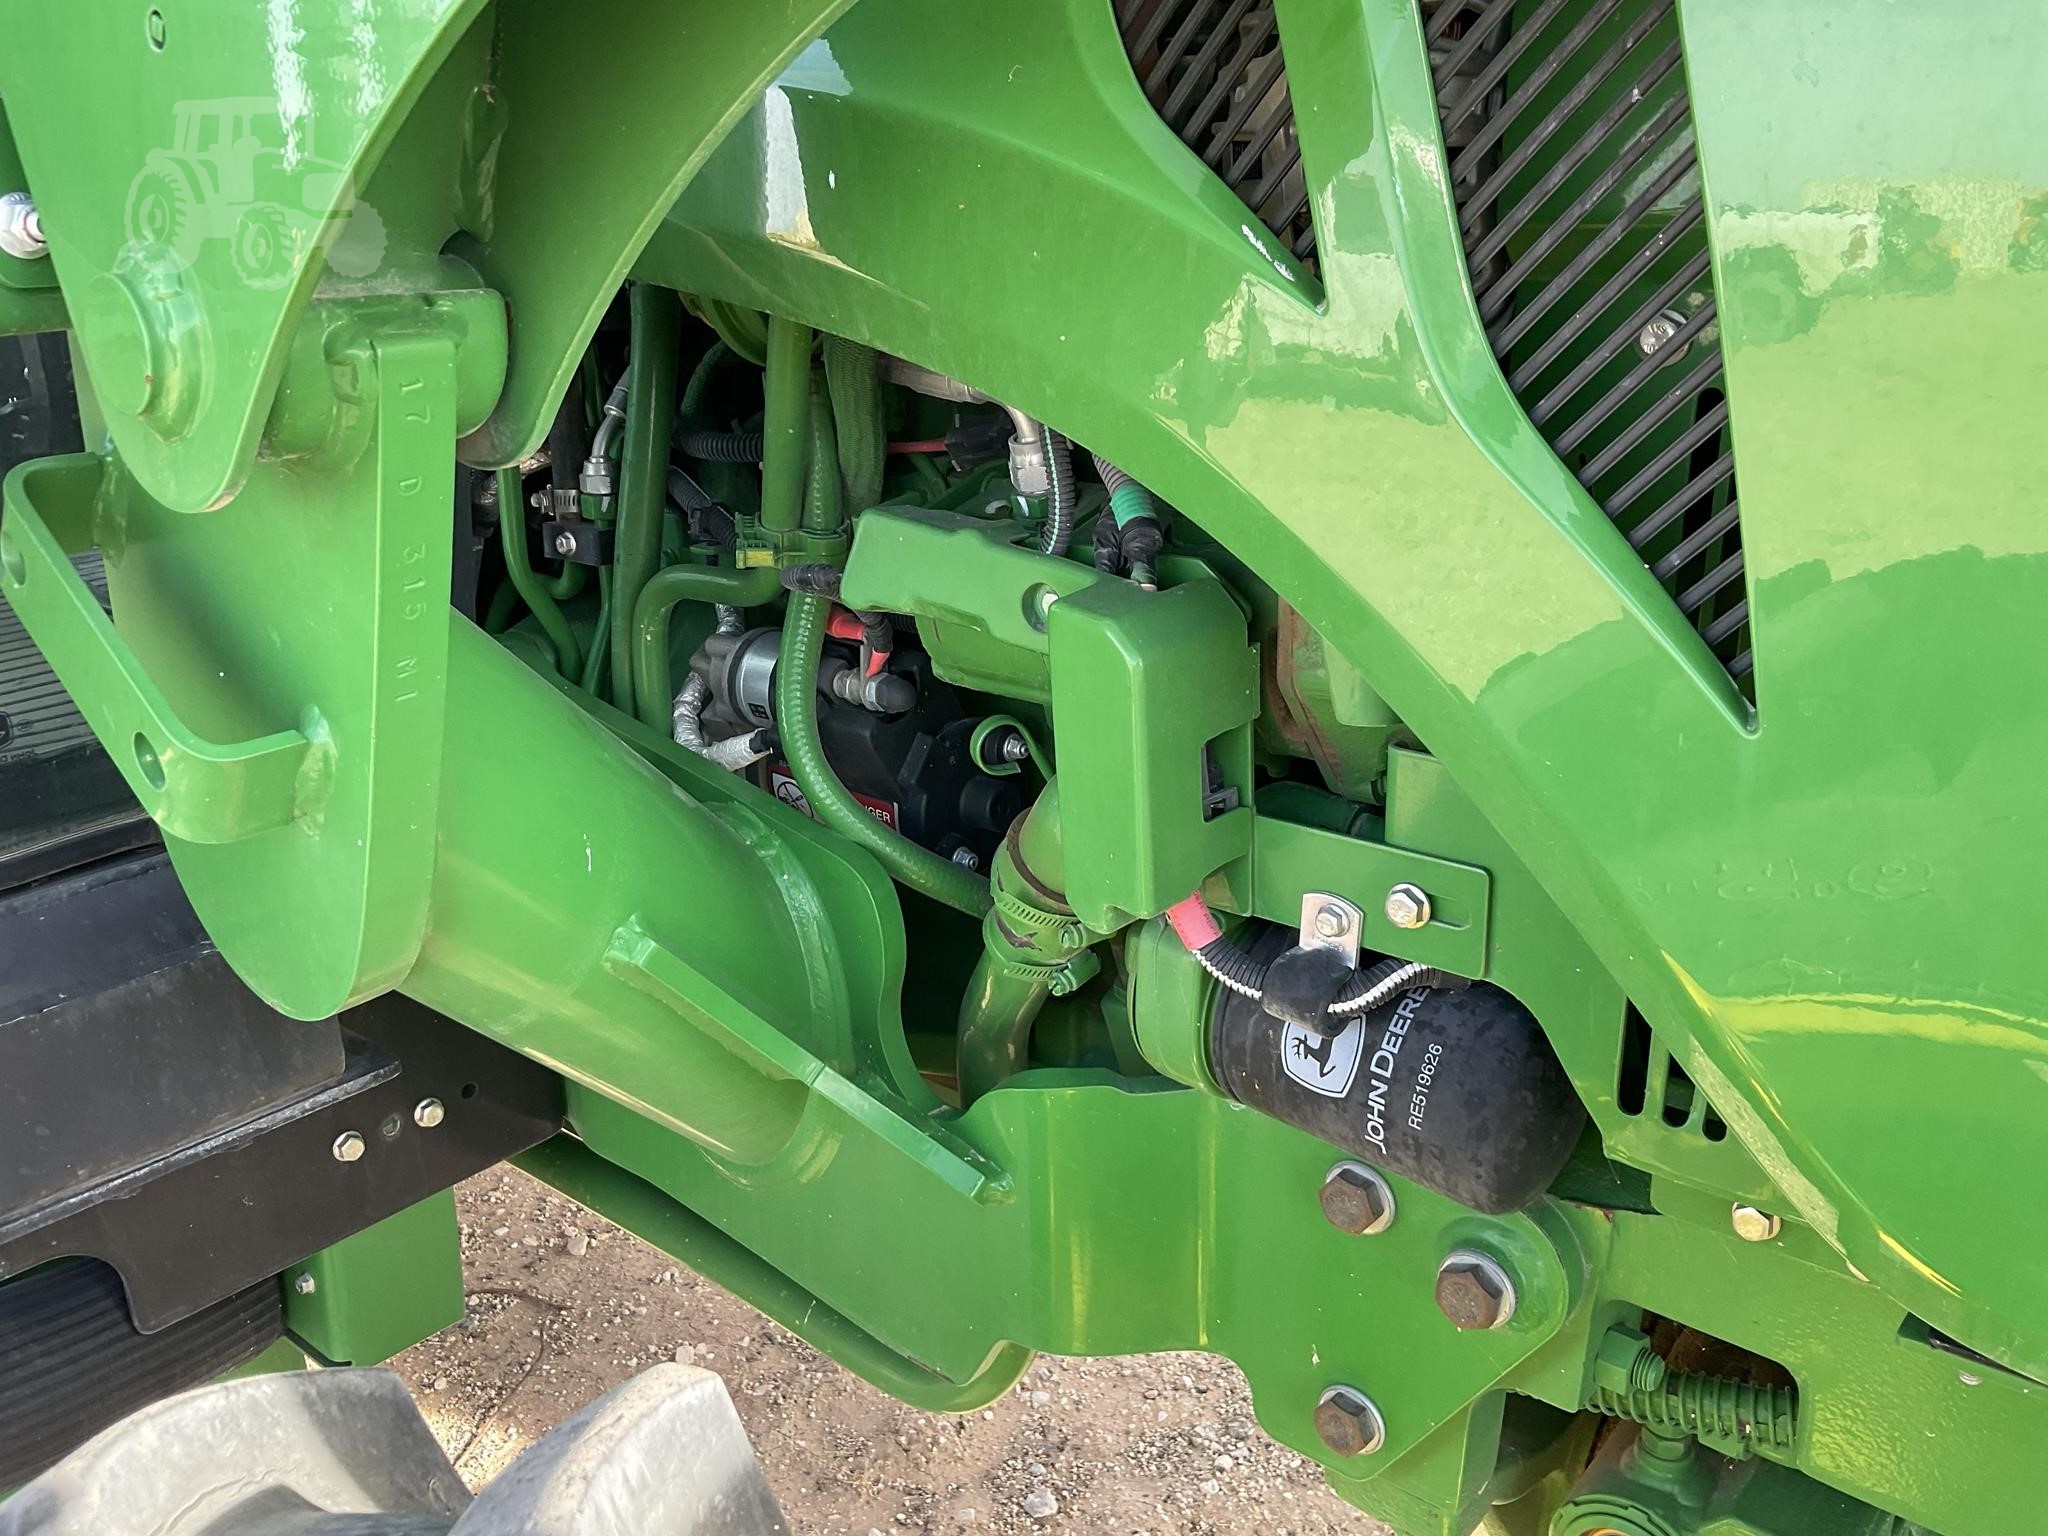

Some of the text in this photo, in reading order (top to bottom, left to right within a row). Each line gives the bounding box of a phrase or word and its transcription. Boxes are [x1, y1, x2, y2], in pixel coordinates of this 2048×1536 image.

[400, 379, 430, 423] 17
[403, 543, 426, 620] 315
[1364, 987, 1431, 1155] JOHN DEERE
[1408, 1043, 1443, 1131] RE519626
